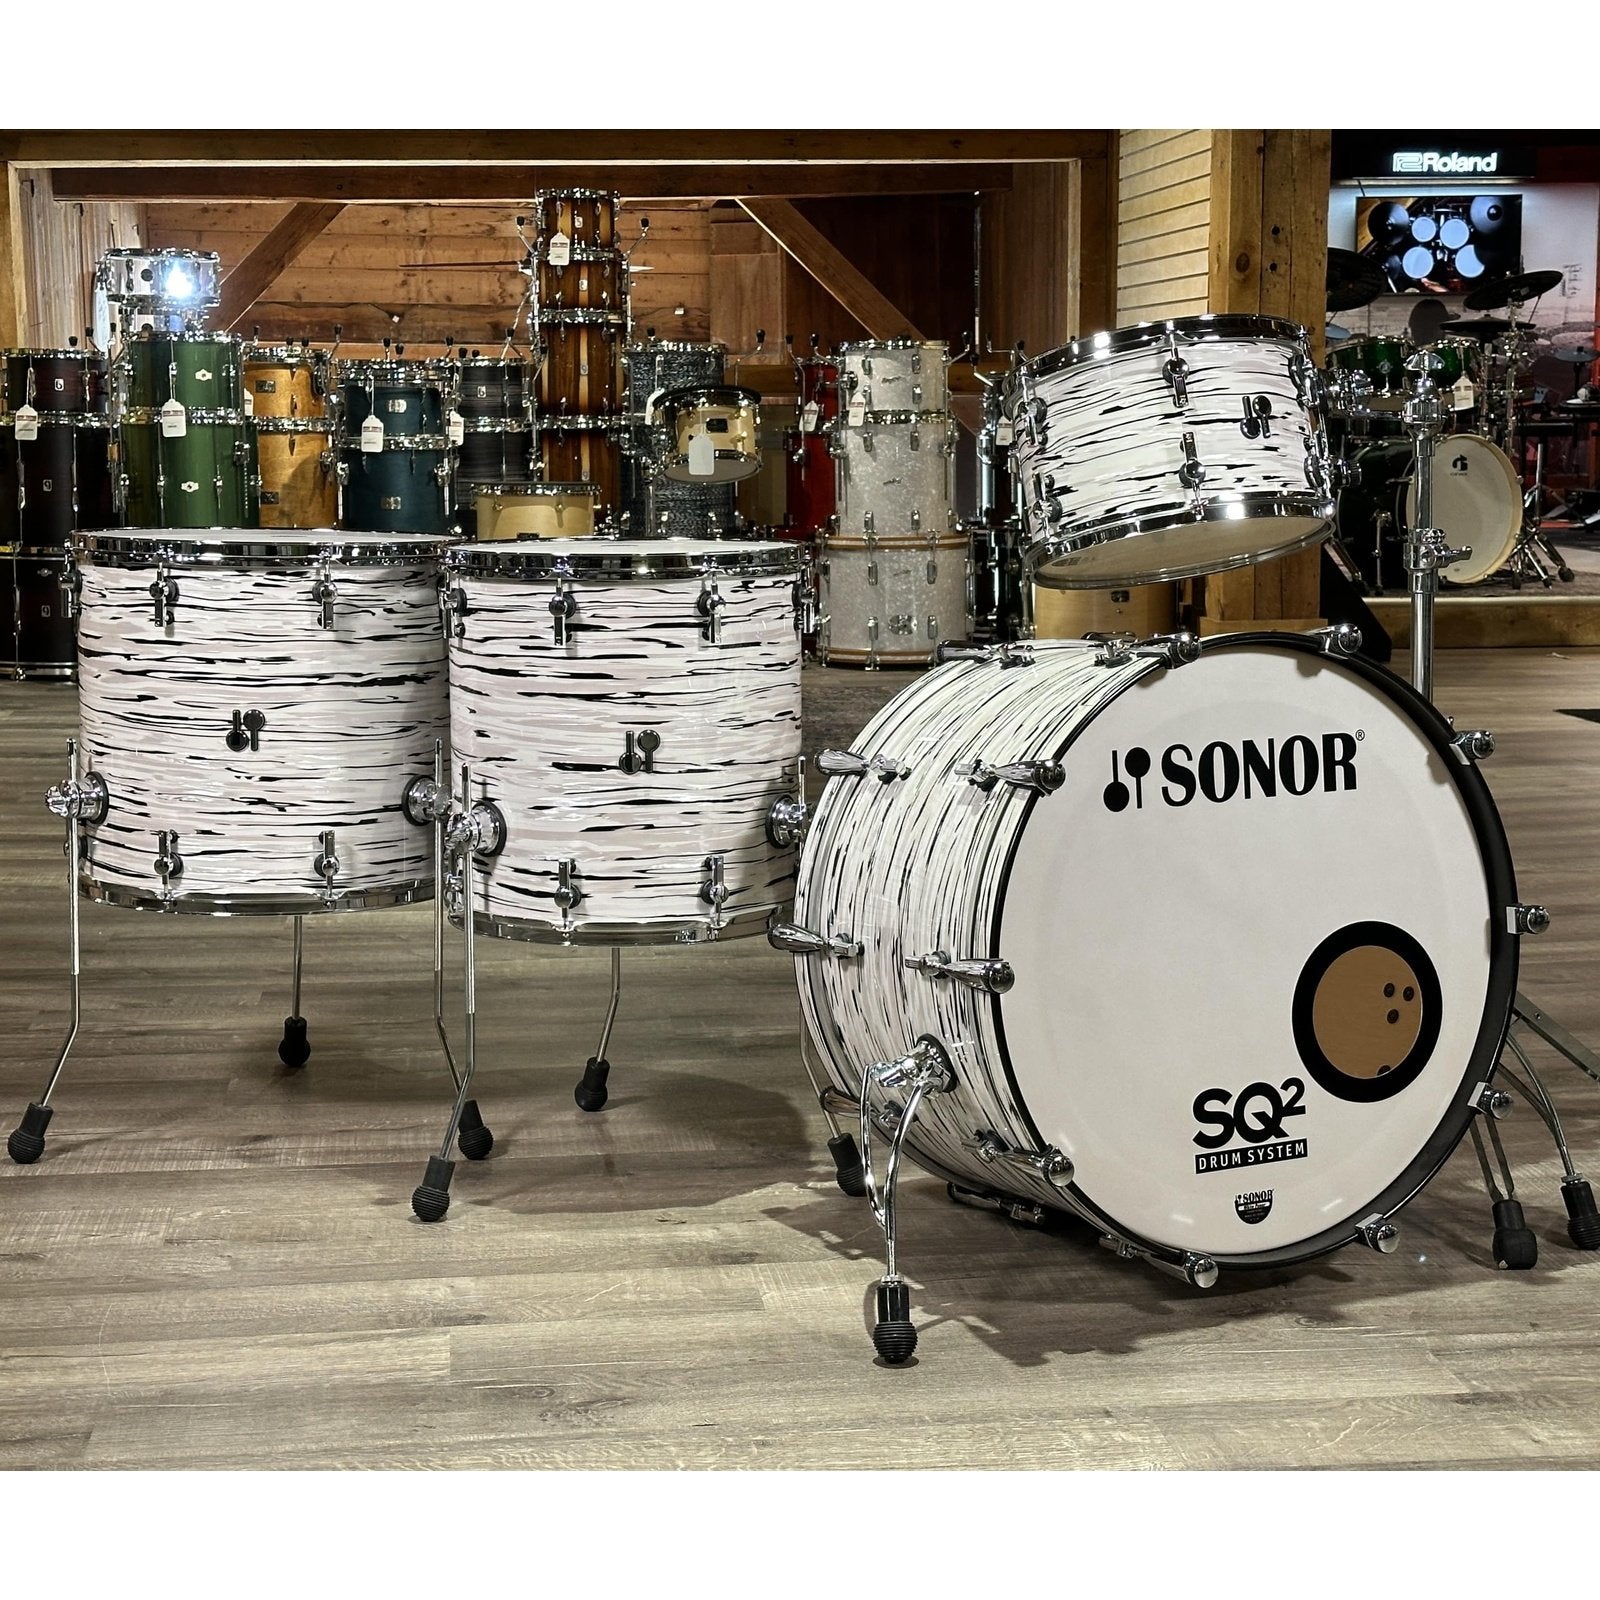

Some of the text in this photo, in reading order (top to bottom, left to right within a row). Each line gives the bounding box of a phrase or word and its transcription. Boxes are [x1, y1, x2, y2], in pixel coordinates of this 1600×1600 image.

[1423, 152, 1497, 171] Roland
[1199, 1142, 1305, 1170] DRUM SYSTEM
